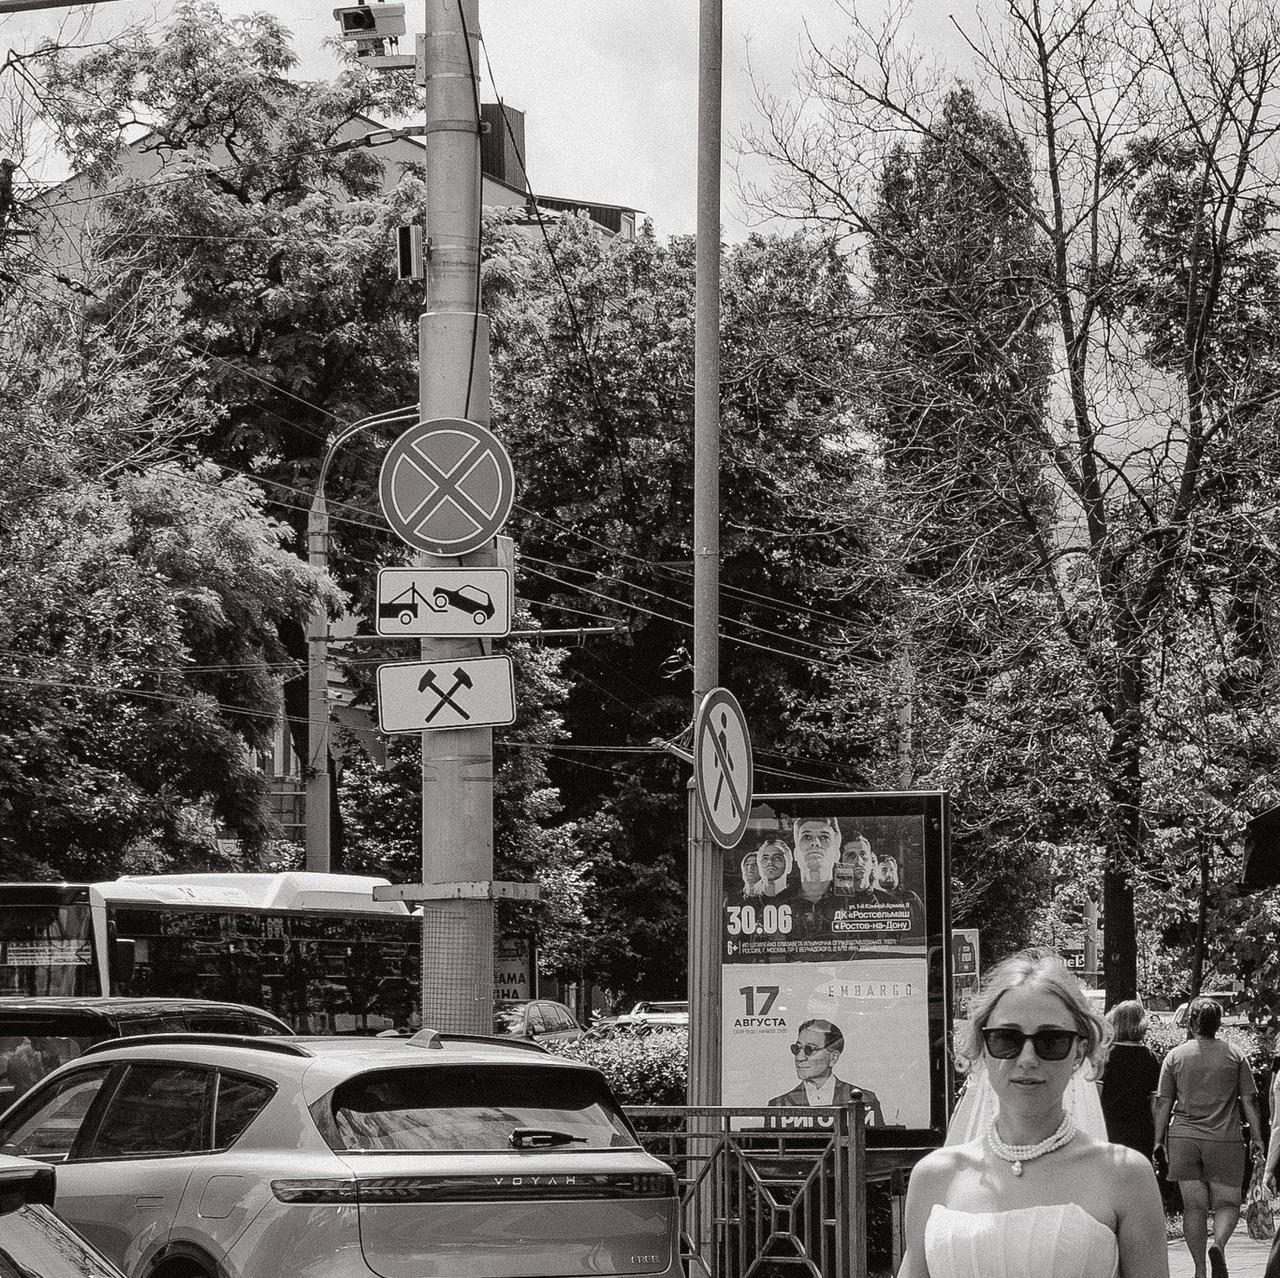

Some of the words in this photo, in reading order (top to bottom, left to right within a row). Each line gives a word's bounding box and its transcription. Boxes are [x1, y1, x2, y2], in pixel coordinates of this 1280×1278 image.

[727, 905, 792, 934] 30.06
[834, 910, 848, 920] ДК
[840, 921, 908, 931] Ростов-на-Дону
[727, 940, 739, 955] 6+
[828, 983, 912, 998] EMBARGO
[739, 985, 779, 1016] 17
[734, 1018, 786, 1027] АВГУСТА
[494, 1176, 576, 1185] VOYAH
[631, 1255, 660, 1264] FREE
